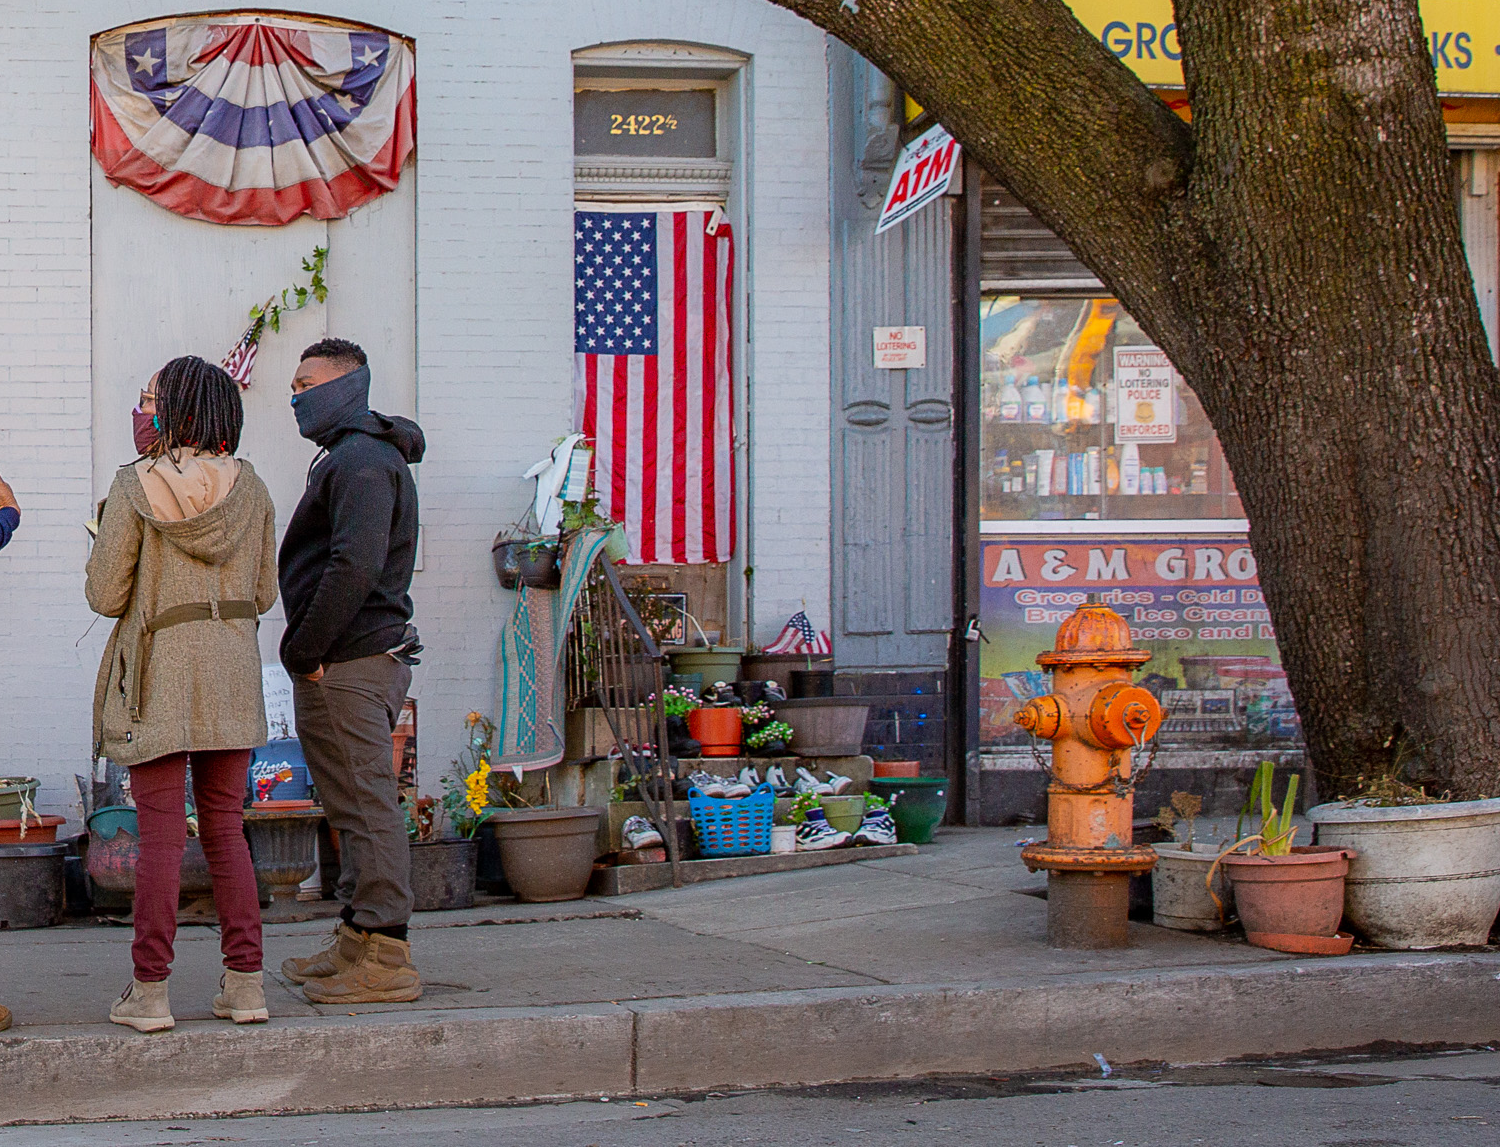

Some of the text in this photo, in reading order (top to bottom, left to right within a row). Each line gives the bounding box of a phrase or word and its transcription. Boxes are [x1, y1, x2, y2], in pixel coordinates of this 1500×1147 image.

[884, 139, 957, 214] ATM
[889, 331, 903, 340] NO
[876, 341, 917, 351] LOITERING
[1118, 354, 1169, 367] WARNING
[1138, 368, 1151, 378] NO
[1119, 378, 1169, 389] LOITERING
[1127, 389, 1161, 400] POLICE
[1119, 424, 1170, 435] ENFORCED
[991, 548, 1027, 582] A
[1040, 548, 1078, 581] &
[1085, 548, 1131, 581] M
[1014, 588, 1154, 605] Grocries
[1177, 589, 1237, 604] Cold
[1134, 606, 1177, 622] Ice
[1197, 623, 1253, 640] and
